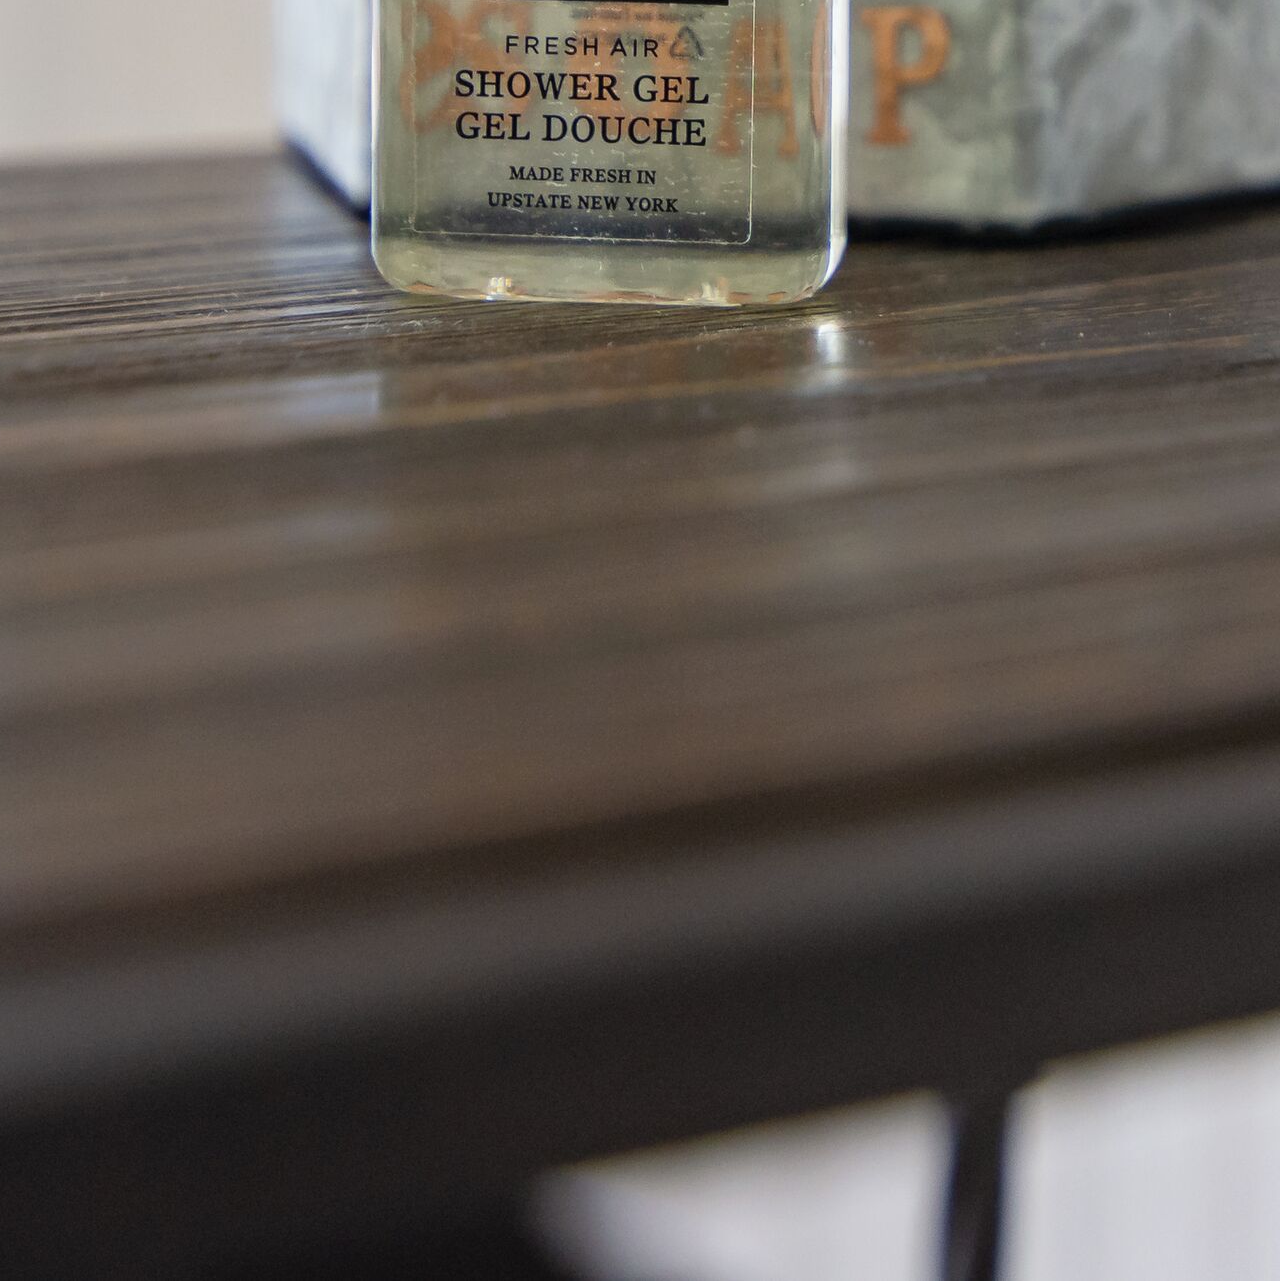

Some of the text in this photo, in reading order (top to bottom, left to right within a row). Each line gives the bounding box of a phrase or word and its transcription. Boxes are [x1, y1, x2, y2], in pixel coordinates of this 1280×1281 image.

[505, 35, 599, 57] FRESH
[609, 37, 659, 58] AIR
[454, 69, 710, 105] SHOWER GEL
[455, 111, 707, 147] GEL DOUCHE
[509, 165, 657, 185] MADE FRESH IN
[488, 192, 678, 213] UPSTATE NEW YORK
